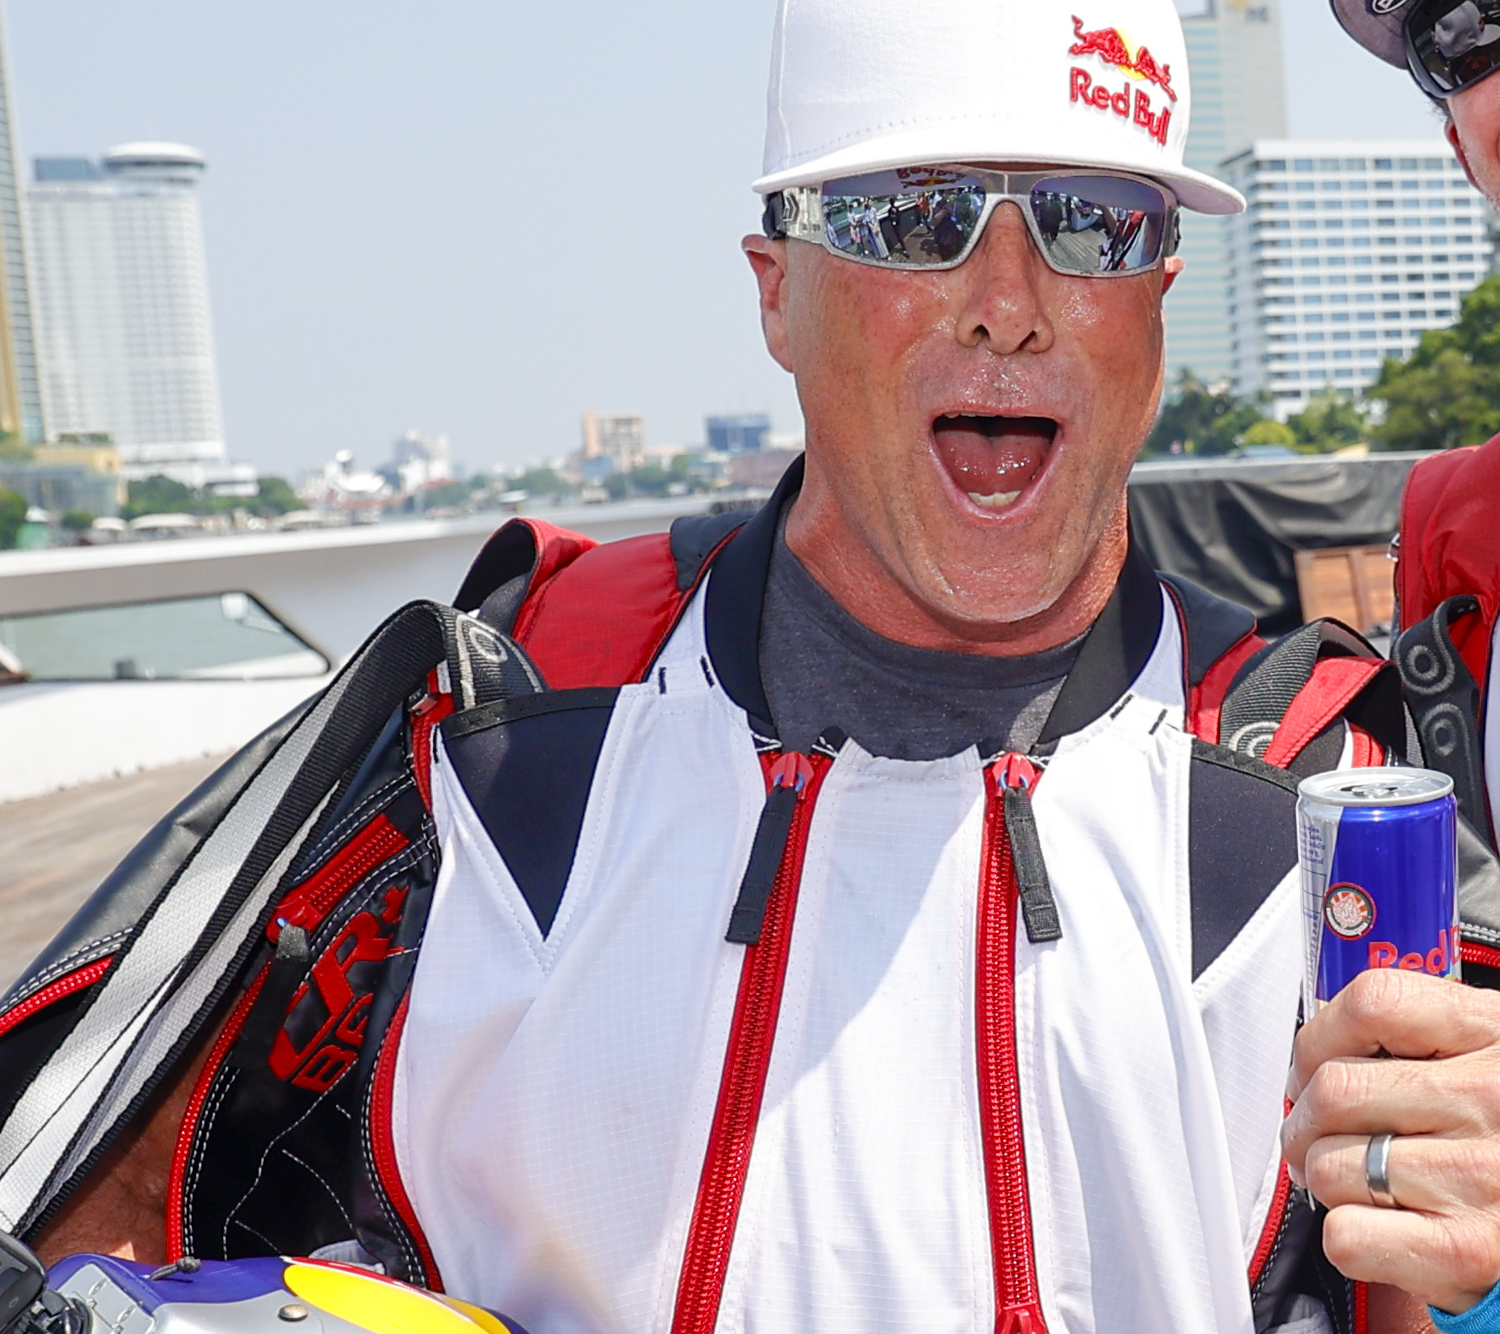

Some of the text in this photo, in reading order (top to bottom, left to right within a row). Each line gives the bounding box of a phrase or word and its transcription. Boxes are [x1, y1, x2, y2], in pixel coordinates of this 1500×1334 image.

[1070, 67, 1171, 146] Red Bull
[1369, 929, 1447, 974] Red
